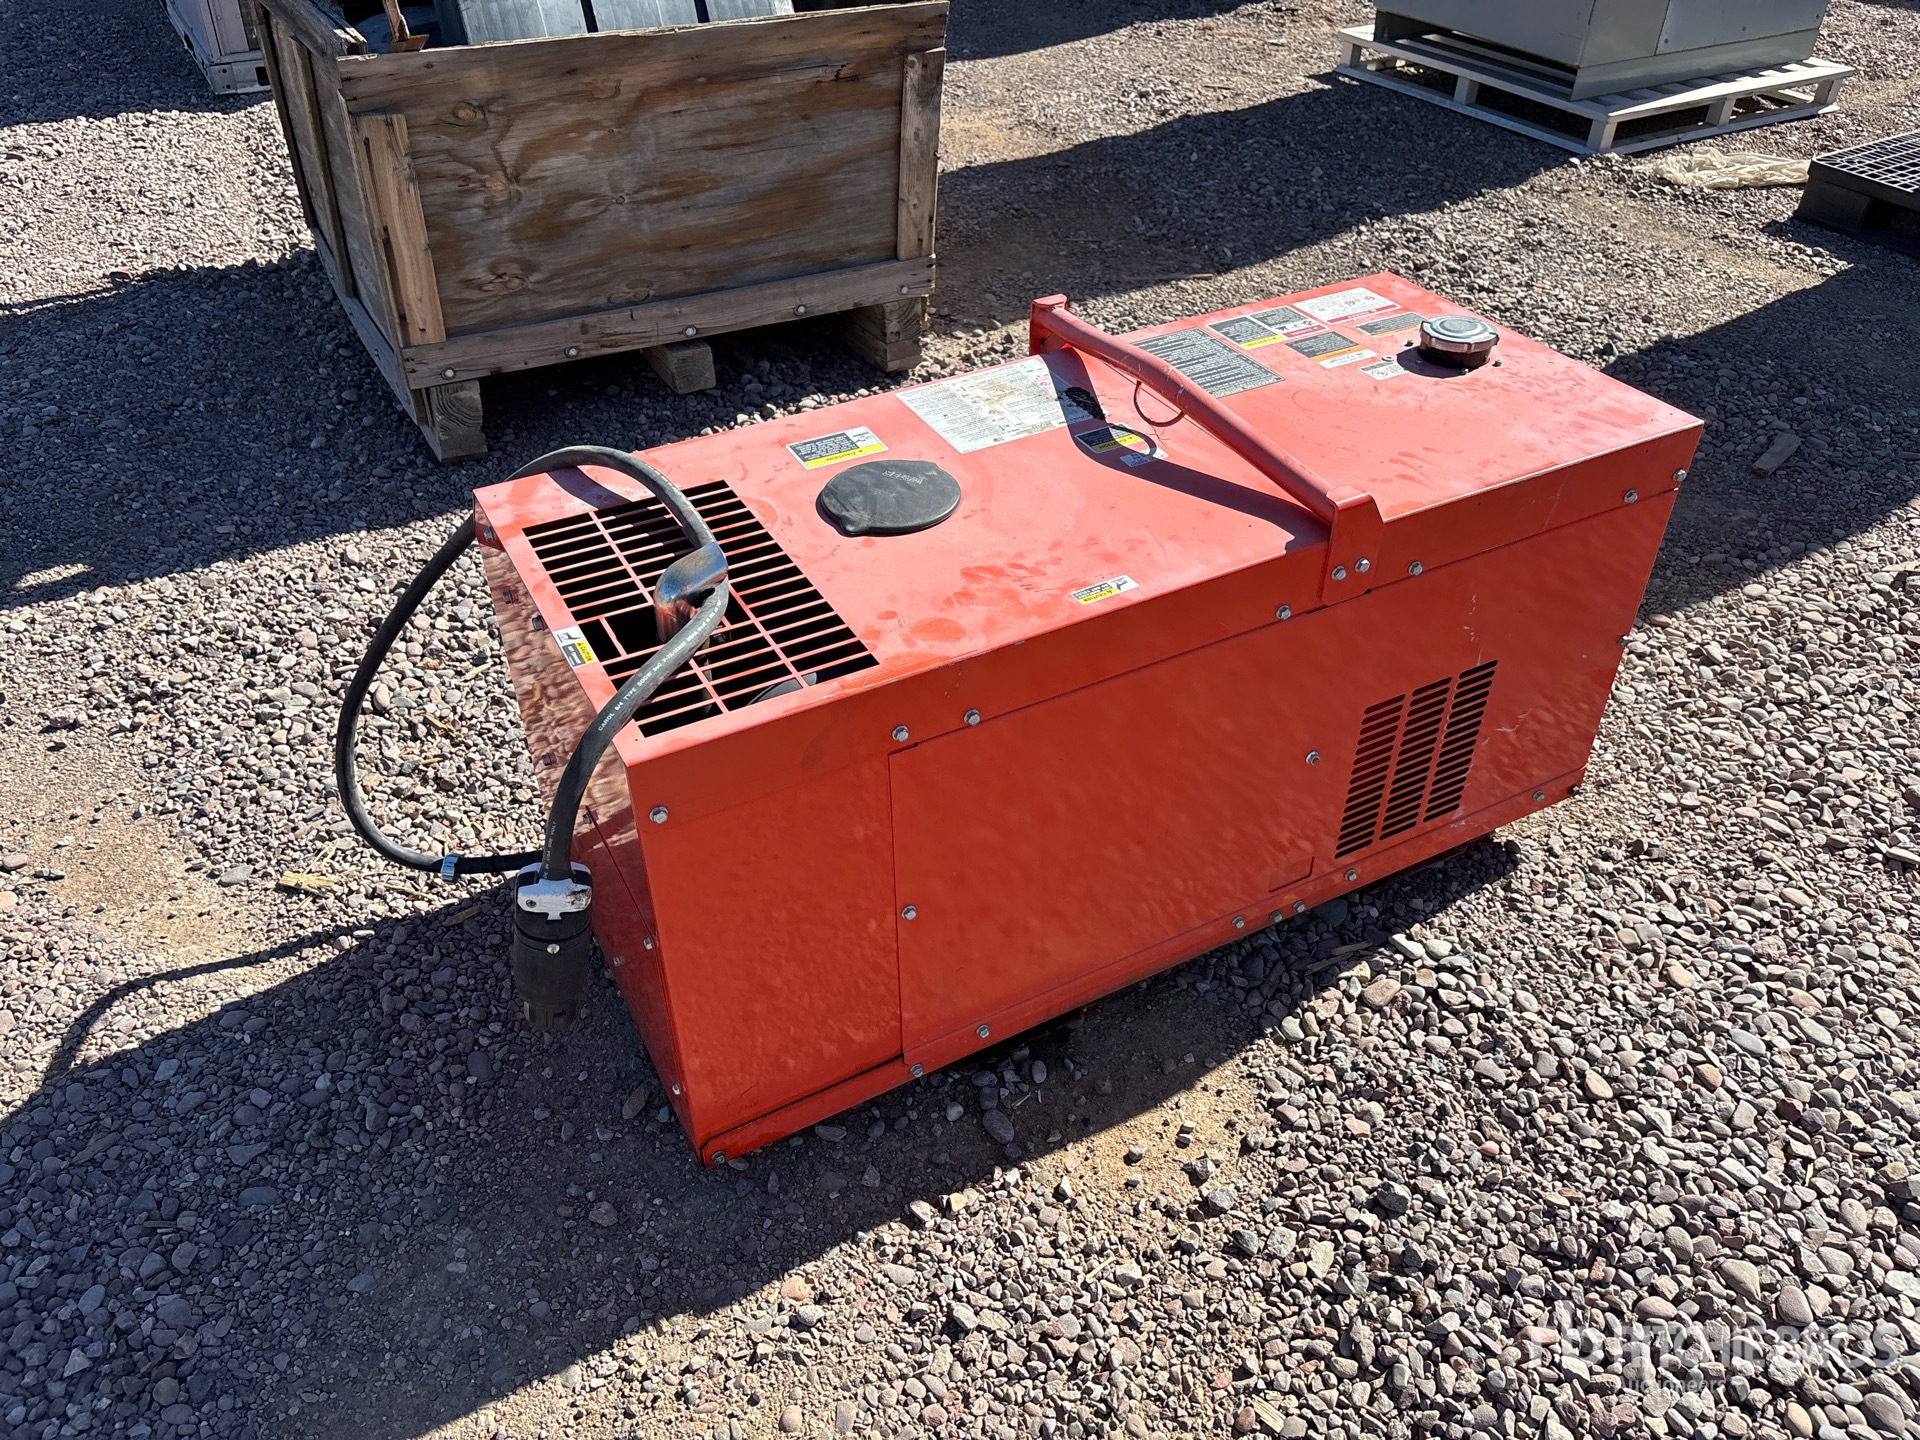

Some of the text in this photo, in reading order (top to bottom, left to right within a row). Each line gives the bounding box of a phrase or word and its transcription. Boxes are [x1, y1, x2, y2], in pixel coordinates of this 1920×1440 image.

[1099, 438, 1127, 450] CAUTION
[826, 451, 856, 462] CAUTION
[1083, 592, 1107, 602] CAUTION
[579, 646, 594, 662] CAUTION
[598, 712, 615, 732] CAROL
[623, 688, 638, 701] TYPE
[637, 671, 653, 687] SOOW
